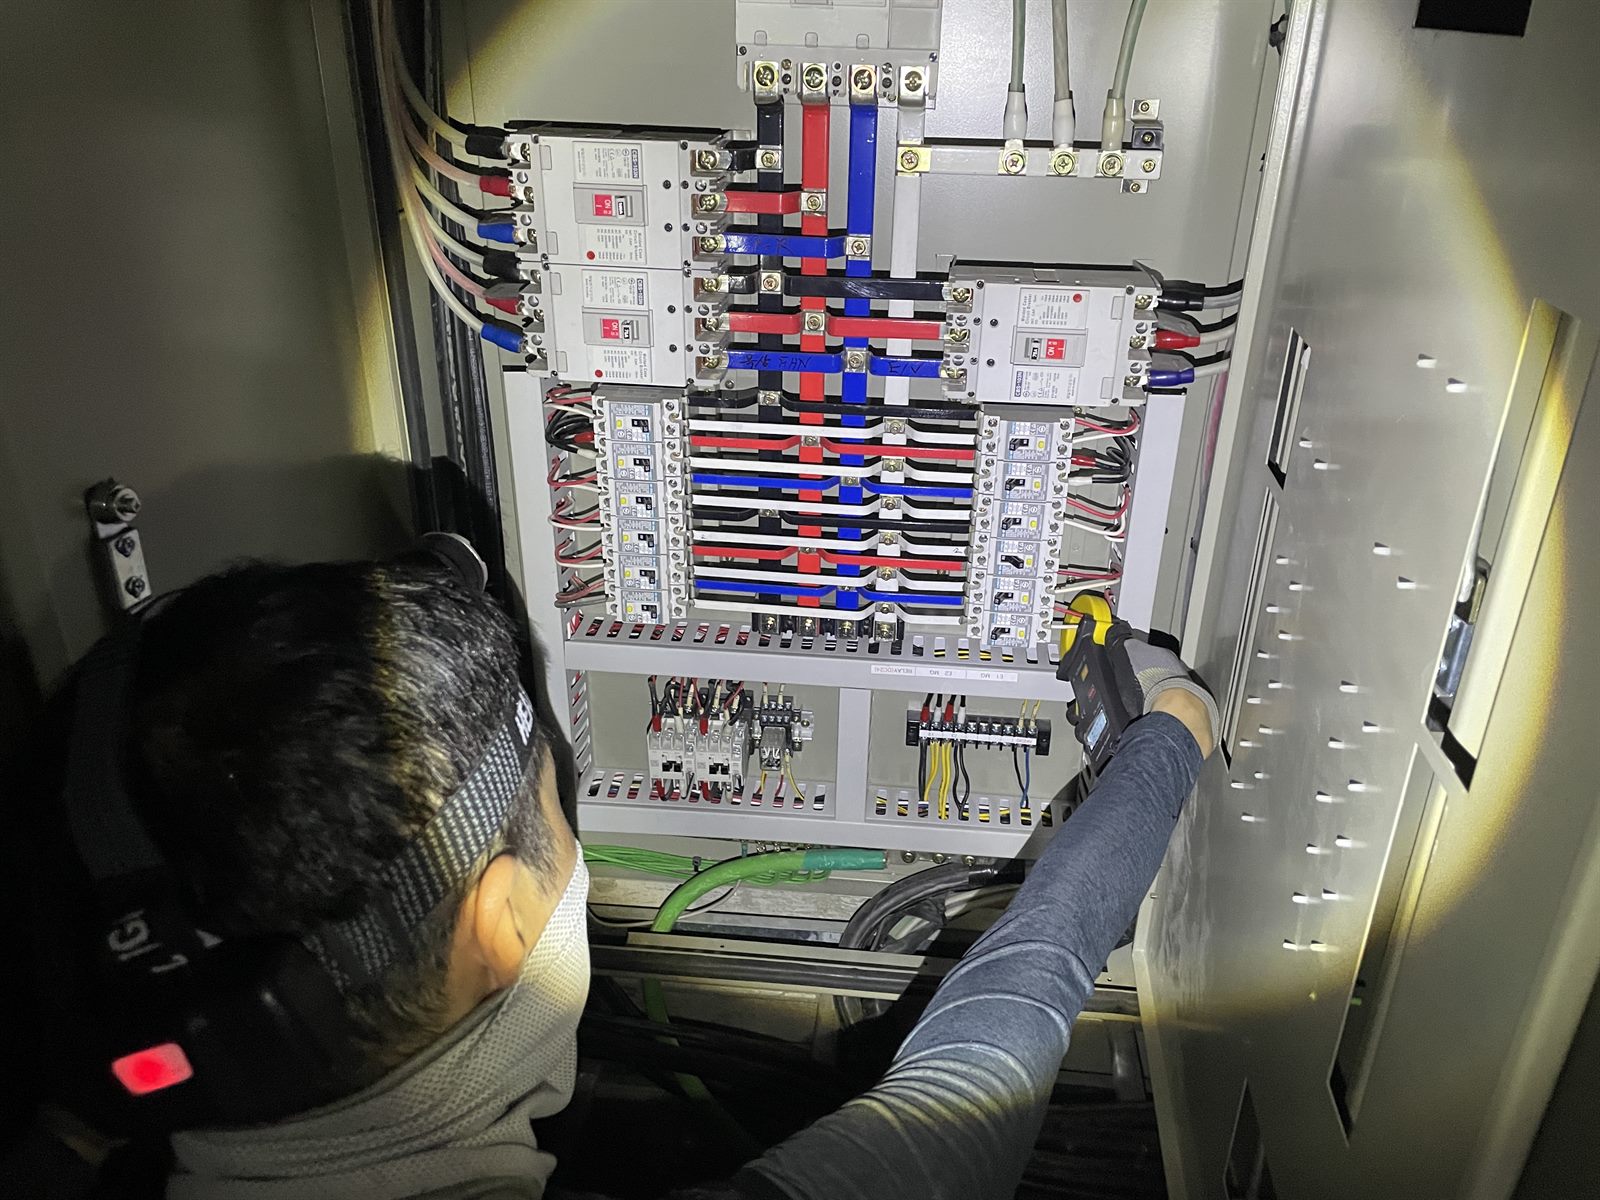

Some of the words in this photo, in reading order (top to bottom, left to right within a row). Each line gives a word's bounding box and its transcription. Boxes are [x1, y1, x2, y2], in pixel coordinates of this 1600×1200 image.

[604, 199, 611, 208] ON
[611, 322, 618, 330] ON
[1047, 347, 1054, 356] ON
